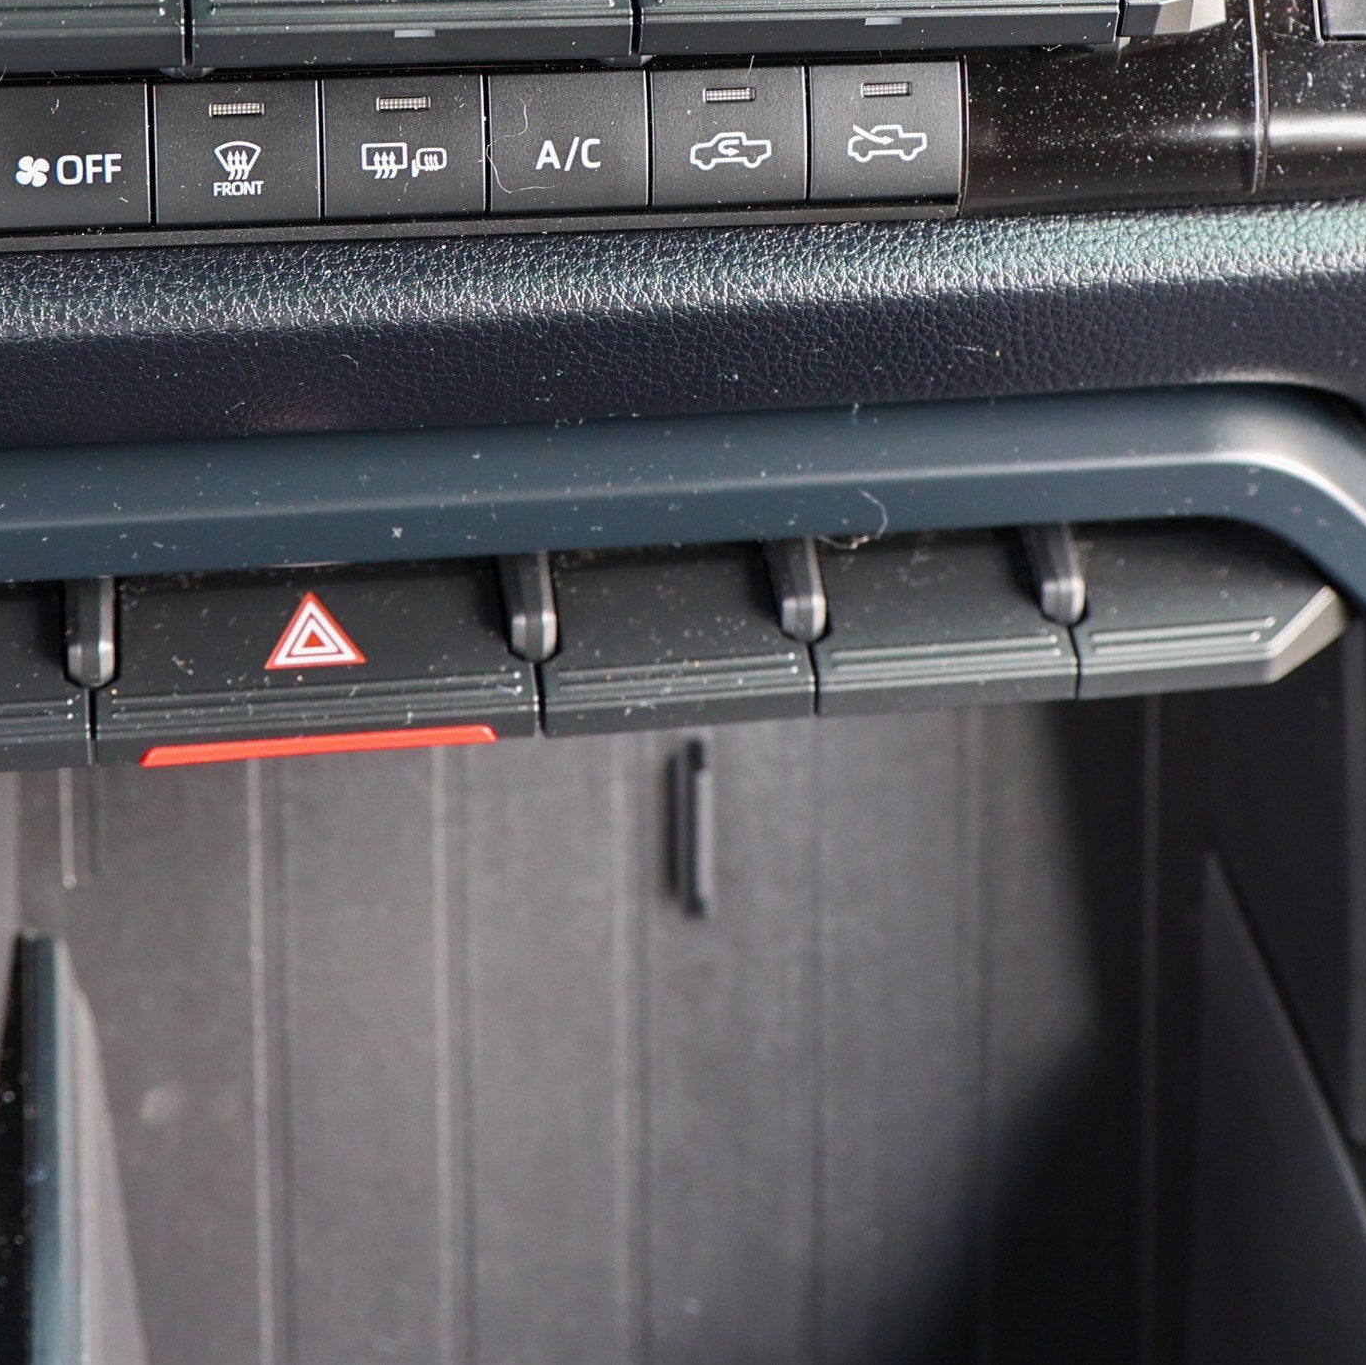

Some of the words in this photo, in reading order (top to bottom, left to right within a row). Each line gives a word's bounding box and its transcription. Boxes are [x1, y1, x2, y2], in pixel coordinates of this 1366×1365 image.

[56, 153, 122, 186] OFF
[535, 137, 602, 171] A/C
[213, 179, 265, 197] FRONT
